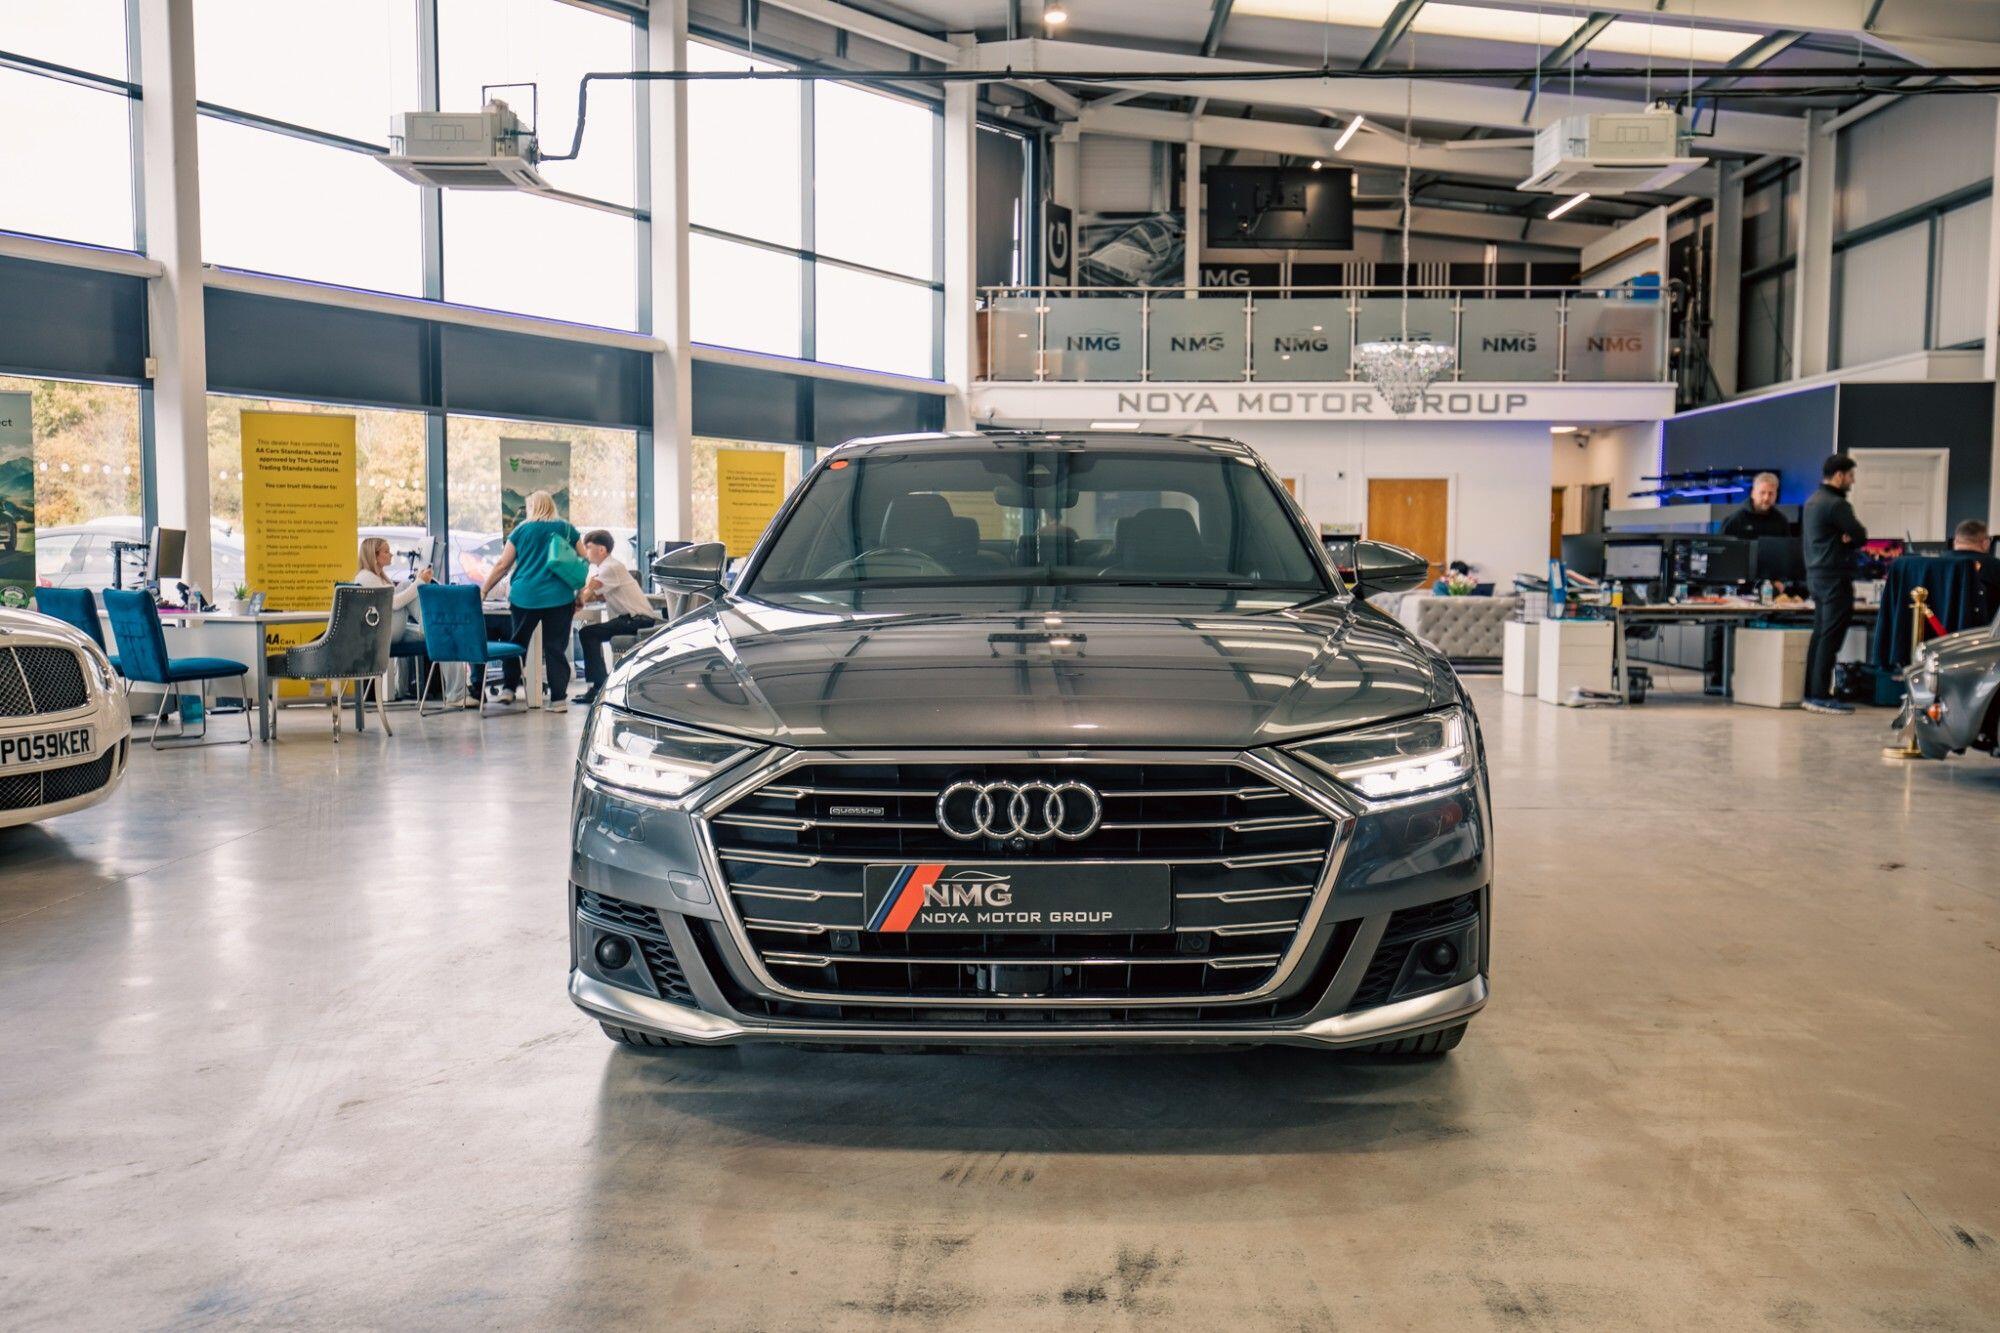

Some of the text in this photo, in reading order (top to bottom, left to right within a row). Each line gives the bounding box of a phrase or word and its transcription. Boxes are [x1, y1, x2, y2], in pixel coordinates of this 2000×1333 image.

[1067, 337, 1120, 351] NMG
[1171, 337, 1224, 351] NMG
[1275, 337, 1328, 351] NMG
[1482, 337, 1536, 352] NMG
[1587, 337, 1641, 351] NMG
[1118, 393, 1218, 413] NOYA
[1238, 393, 1372, 413] MOTOR
[266, 633, 279, 645] AA
[1, 729, 90, 764] PO59KER
[832, 807, 882, 815] quattro
[922, 883, 1013, 907] NMG
[921, 911, 1113, 923] NOYA MOTOR GROUP
